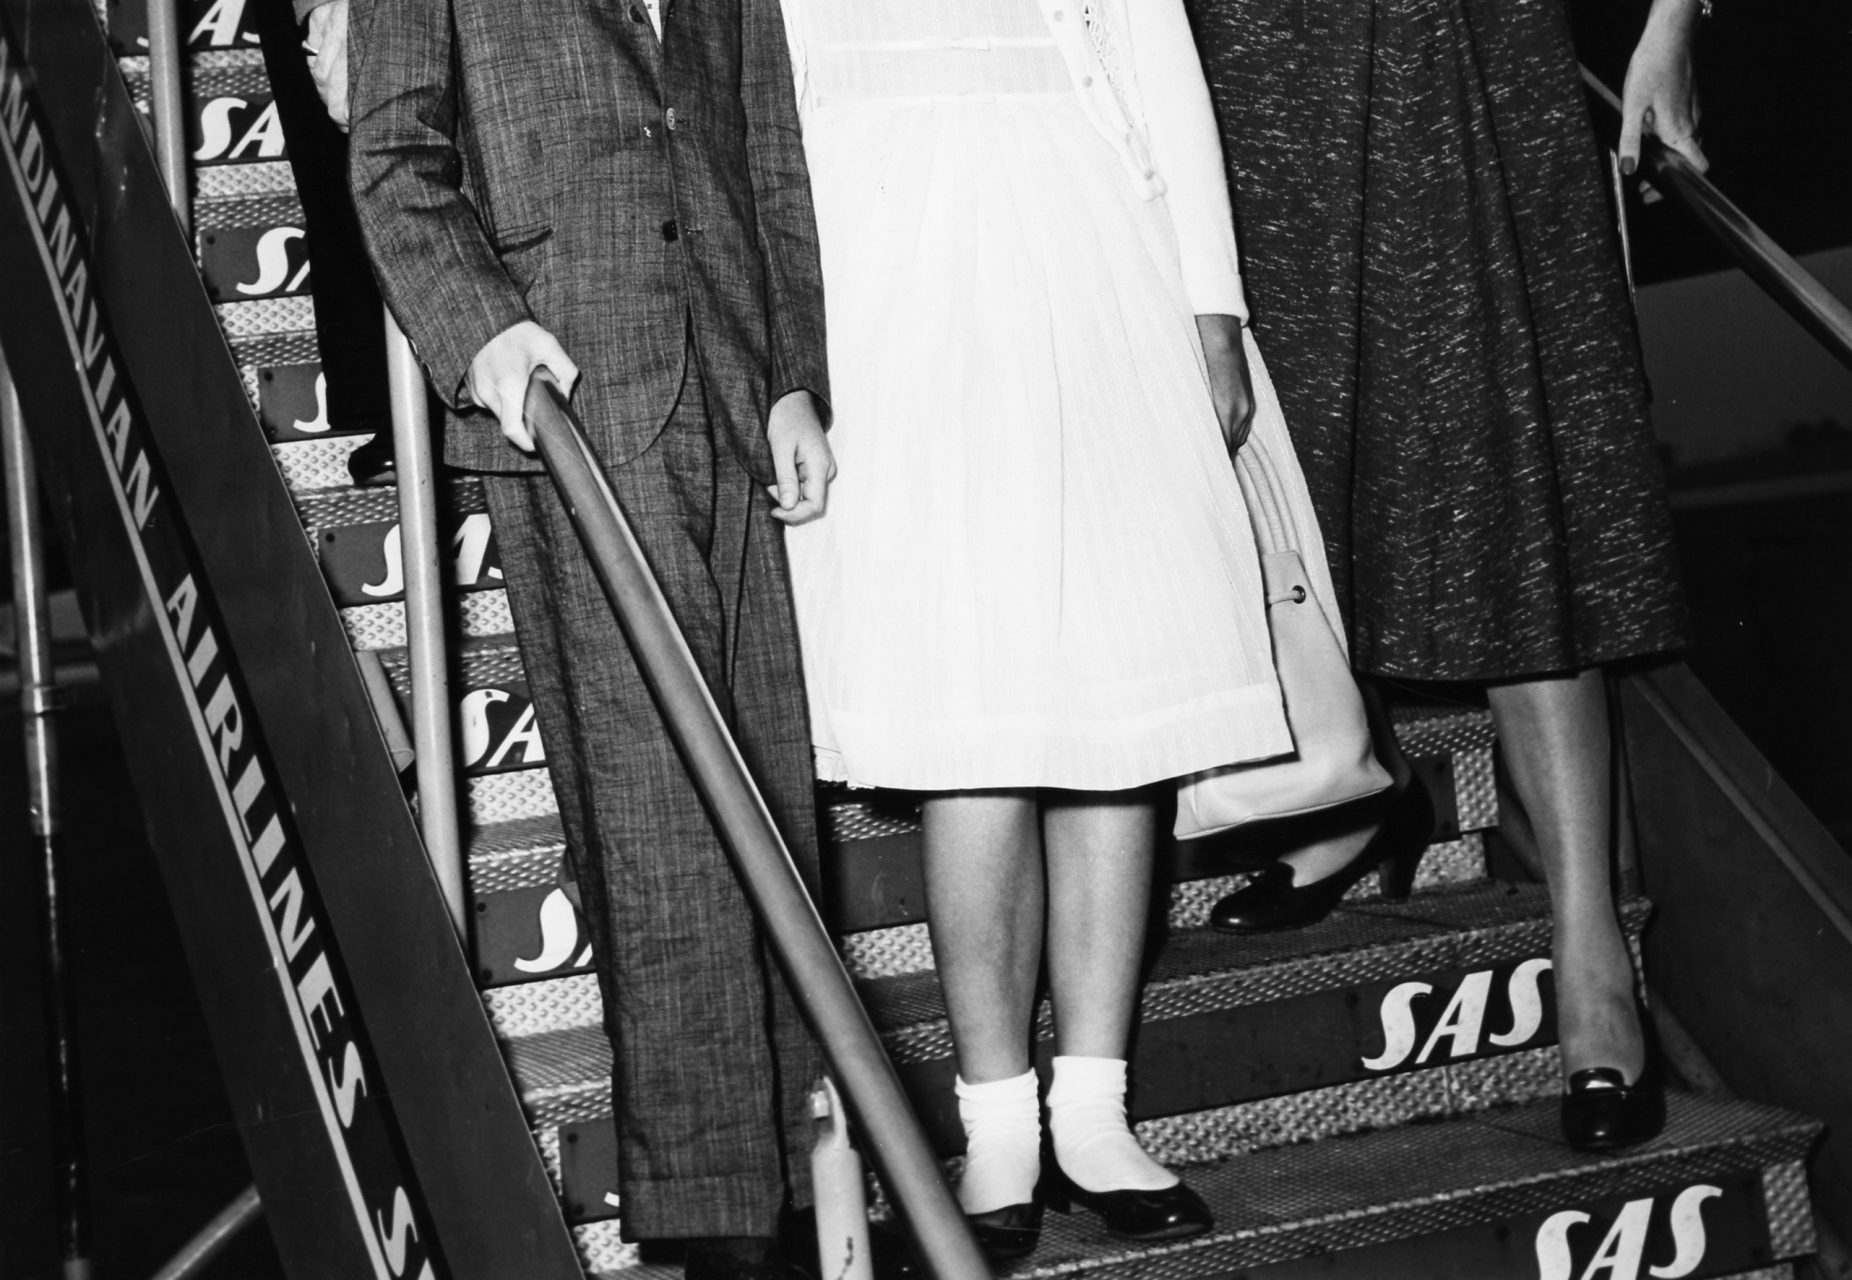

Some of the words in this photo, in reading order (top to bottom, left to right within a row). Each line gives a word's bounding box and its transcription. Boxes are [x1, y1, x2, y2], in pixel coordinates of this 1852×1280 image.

[193, 96, 286, 161] SA
[460, 688, 546, 768] SA
[166, 574, 367, 1129] AIRLINES
[377, 1185, 436, 1280] S
[1361, 958, 1554, 1071] SAS
[1535, 1184, 1723, 1280] SAS
